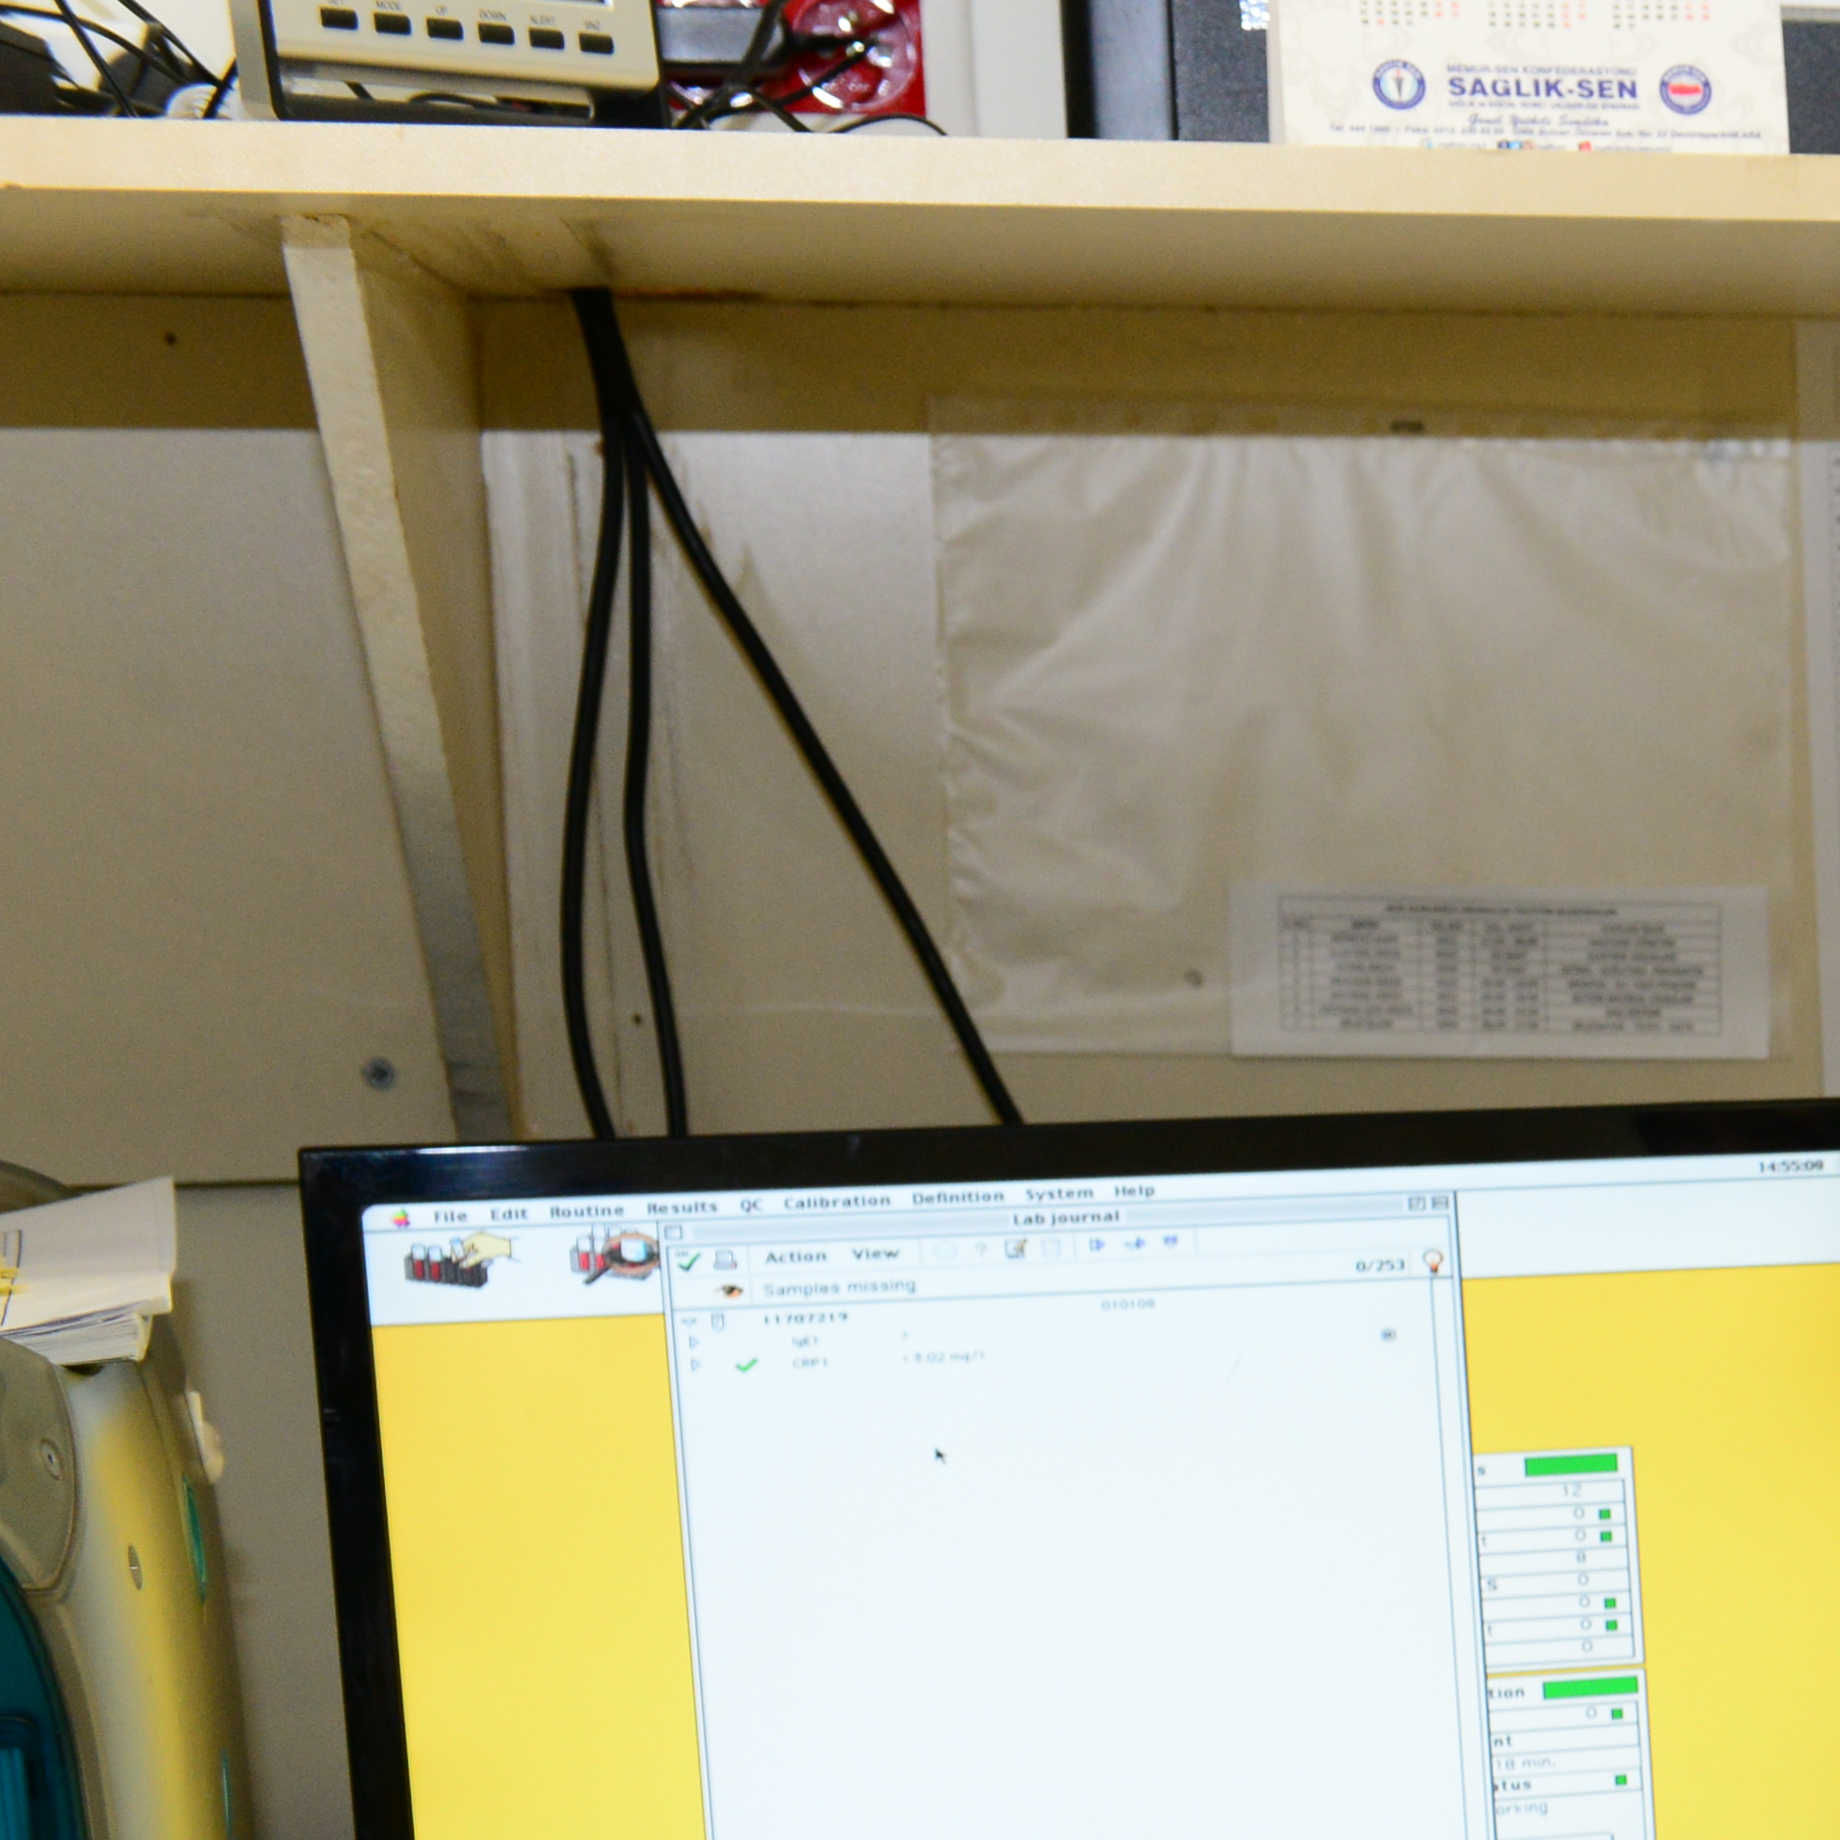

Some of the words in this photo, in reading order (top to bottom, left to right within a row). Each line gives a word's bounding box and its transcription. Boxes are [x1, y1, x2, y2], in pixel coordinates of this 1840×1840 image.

[433, 1210, 468, 1223] File
[489, 1208, 529, 1221] Edit
[549, 1205, 625, 1219] Routine
[646, 1201, 718, 1215] Results
[740, 1199, 764, 1213] QC
[784, 1194, 892, 1210] Calibration
[912, 1190, 1005, 1205] Definition
[1026, 1186, 1095, 1201] System
[1114, 1184, 1156, 1198] Help
[1013, 1211, 1046, 1225] Lab
[1050, 1209, 1121, 1225] journal
[765, 1250, 828, 1265] Action
[852, 1247, 900, 1260] View
[763, 1282, 841, 1298] Samples
[848, 1278, 916, 1295] missing
[1521, 1755, 1557, 1769] min.
